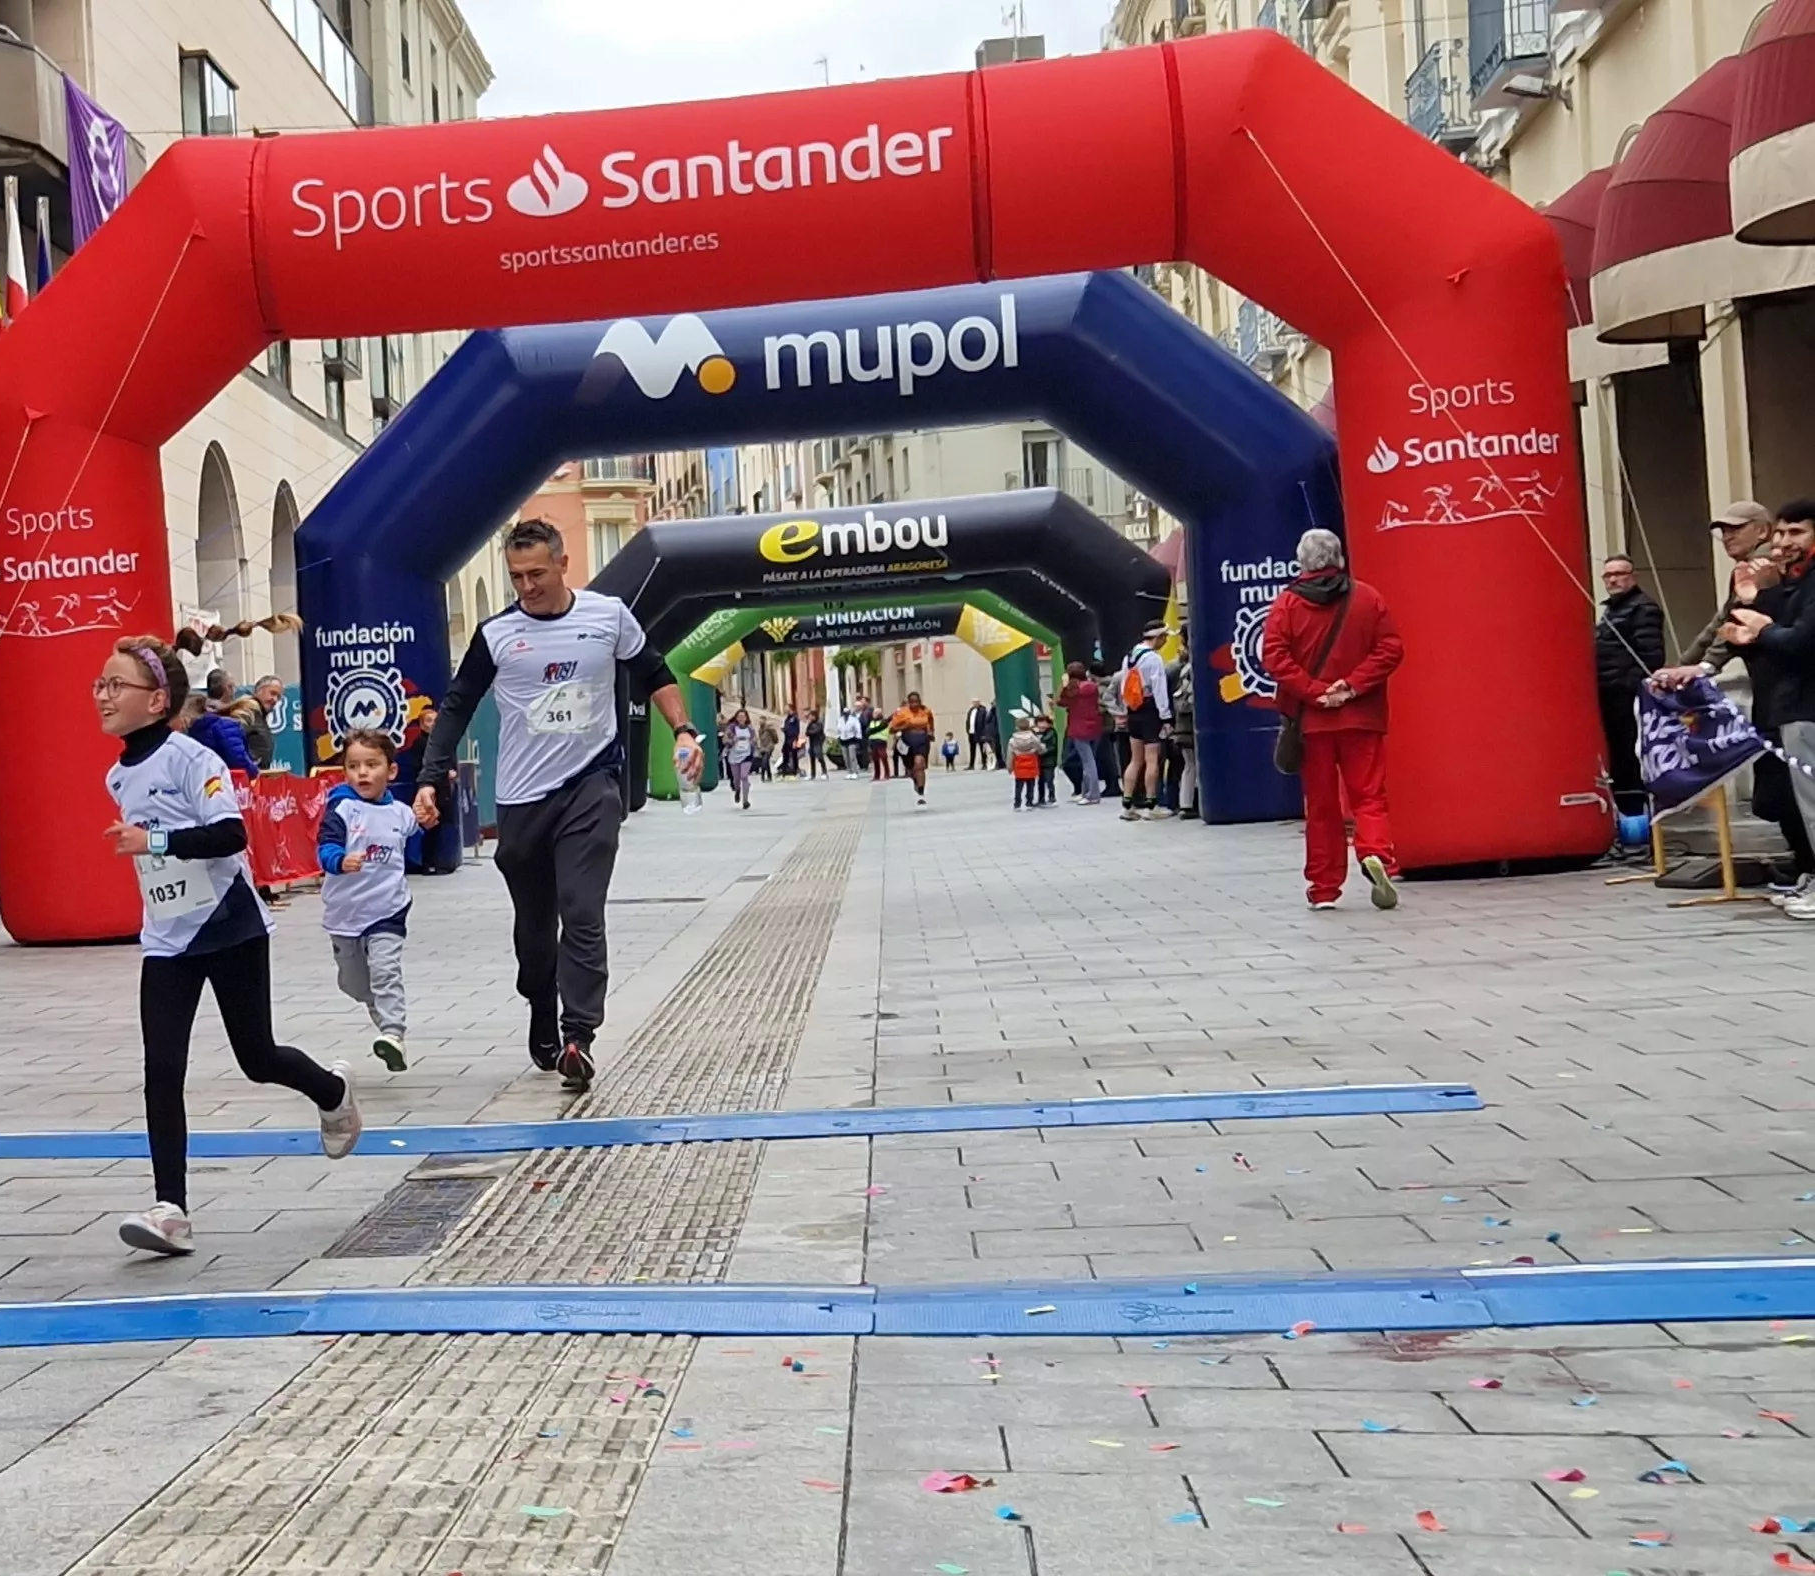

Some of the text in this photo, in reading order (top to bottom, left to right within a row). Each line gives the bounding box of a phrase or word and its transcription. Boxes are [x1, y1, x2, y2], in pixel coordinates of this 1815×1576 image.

[291, 124, 953, 250] Sports Santander
[498, 229, 720, 274] sportssantander.es
[763, 294, 1019, 395] mupol
[1408, 377, 1515, 419] Sports
[1403, 427, 1560, 468] Santander
[6, 505, 94, 541] Sports
[759, 510, 949, 564] embou
[3, 548, 140, 583] Santander
[762, 559, 949, 583] PÁSATE A LA OPERADORA ARAGONESA
[1220, 555, 1302, 583] fundac
[1240, 584, 1287, 604] mu
[315, 620, 415, 648] fundación
[791, 619, 942, 642] CAJA RURAL DE ARAGÓN
[330, 643, 396, 670] mupol
[546, 710, 573, 723] 361
[148, 879, 188, 905] 1037
